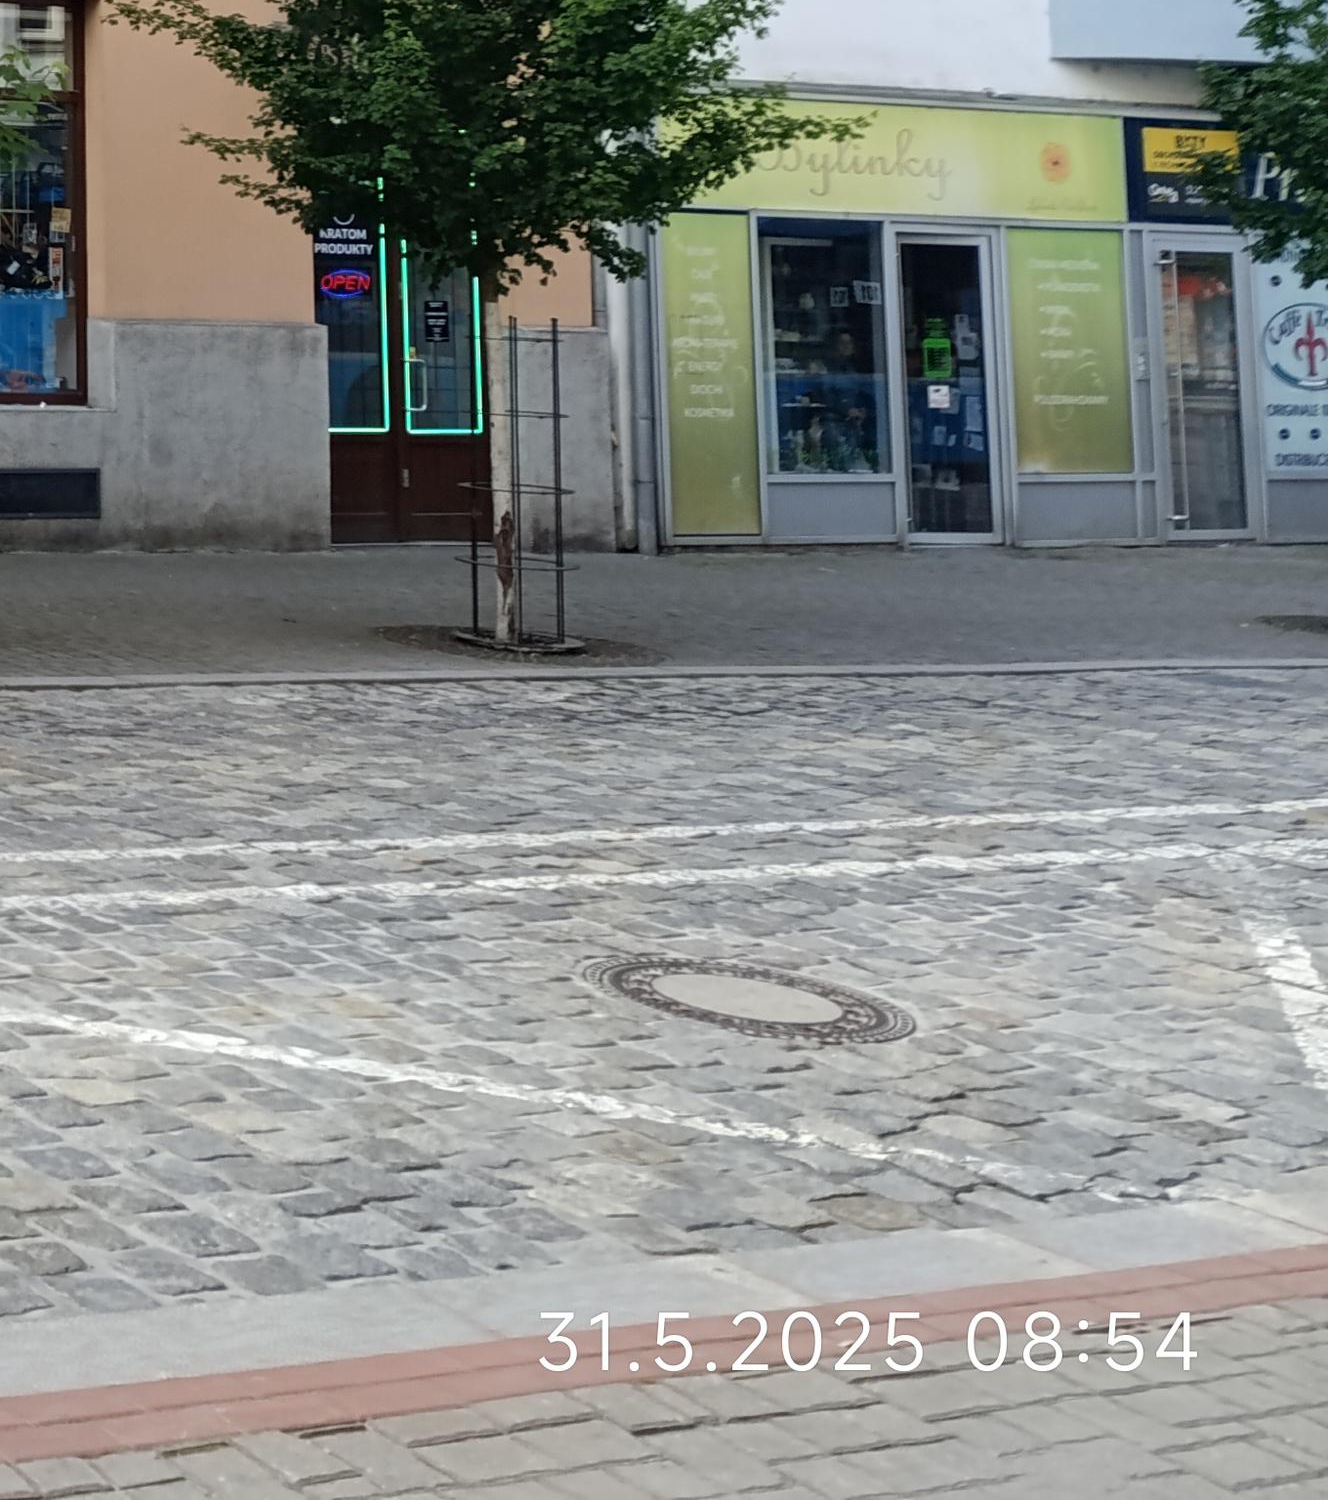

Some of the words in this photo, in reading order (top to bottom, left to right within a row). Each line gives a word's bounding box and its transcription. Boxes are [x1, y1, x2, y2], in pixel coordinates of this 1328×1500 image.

[319, 228, 367, 240] KRATOM
[314, 242, 373, 255] PRODUKTY
[320, 274, 372, 291] OPEN
